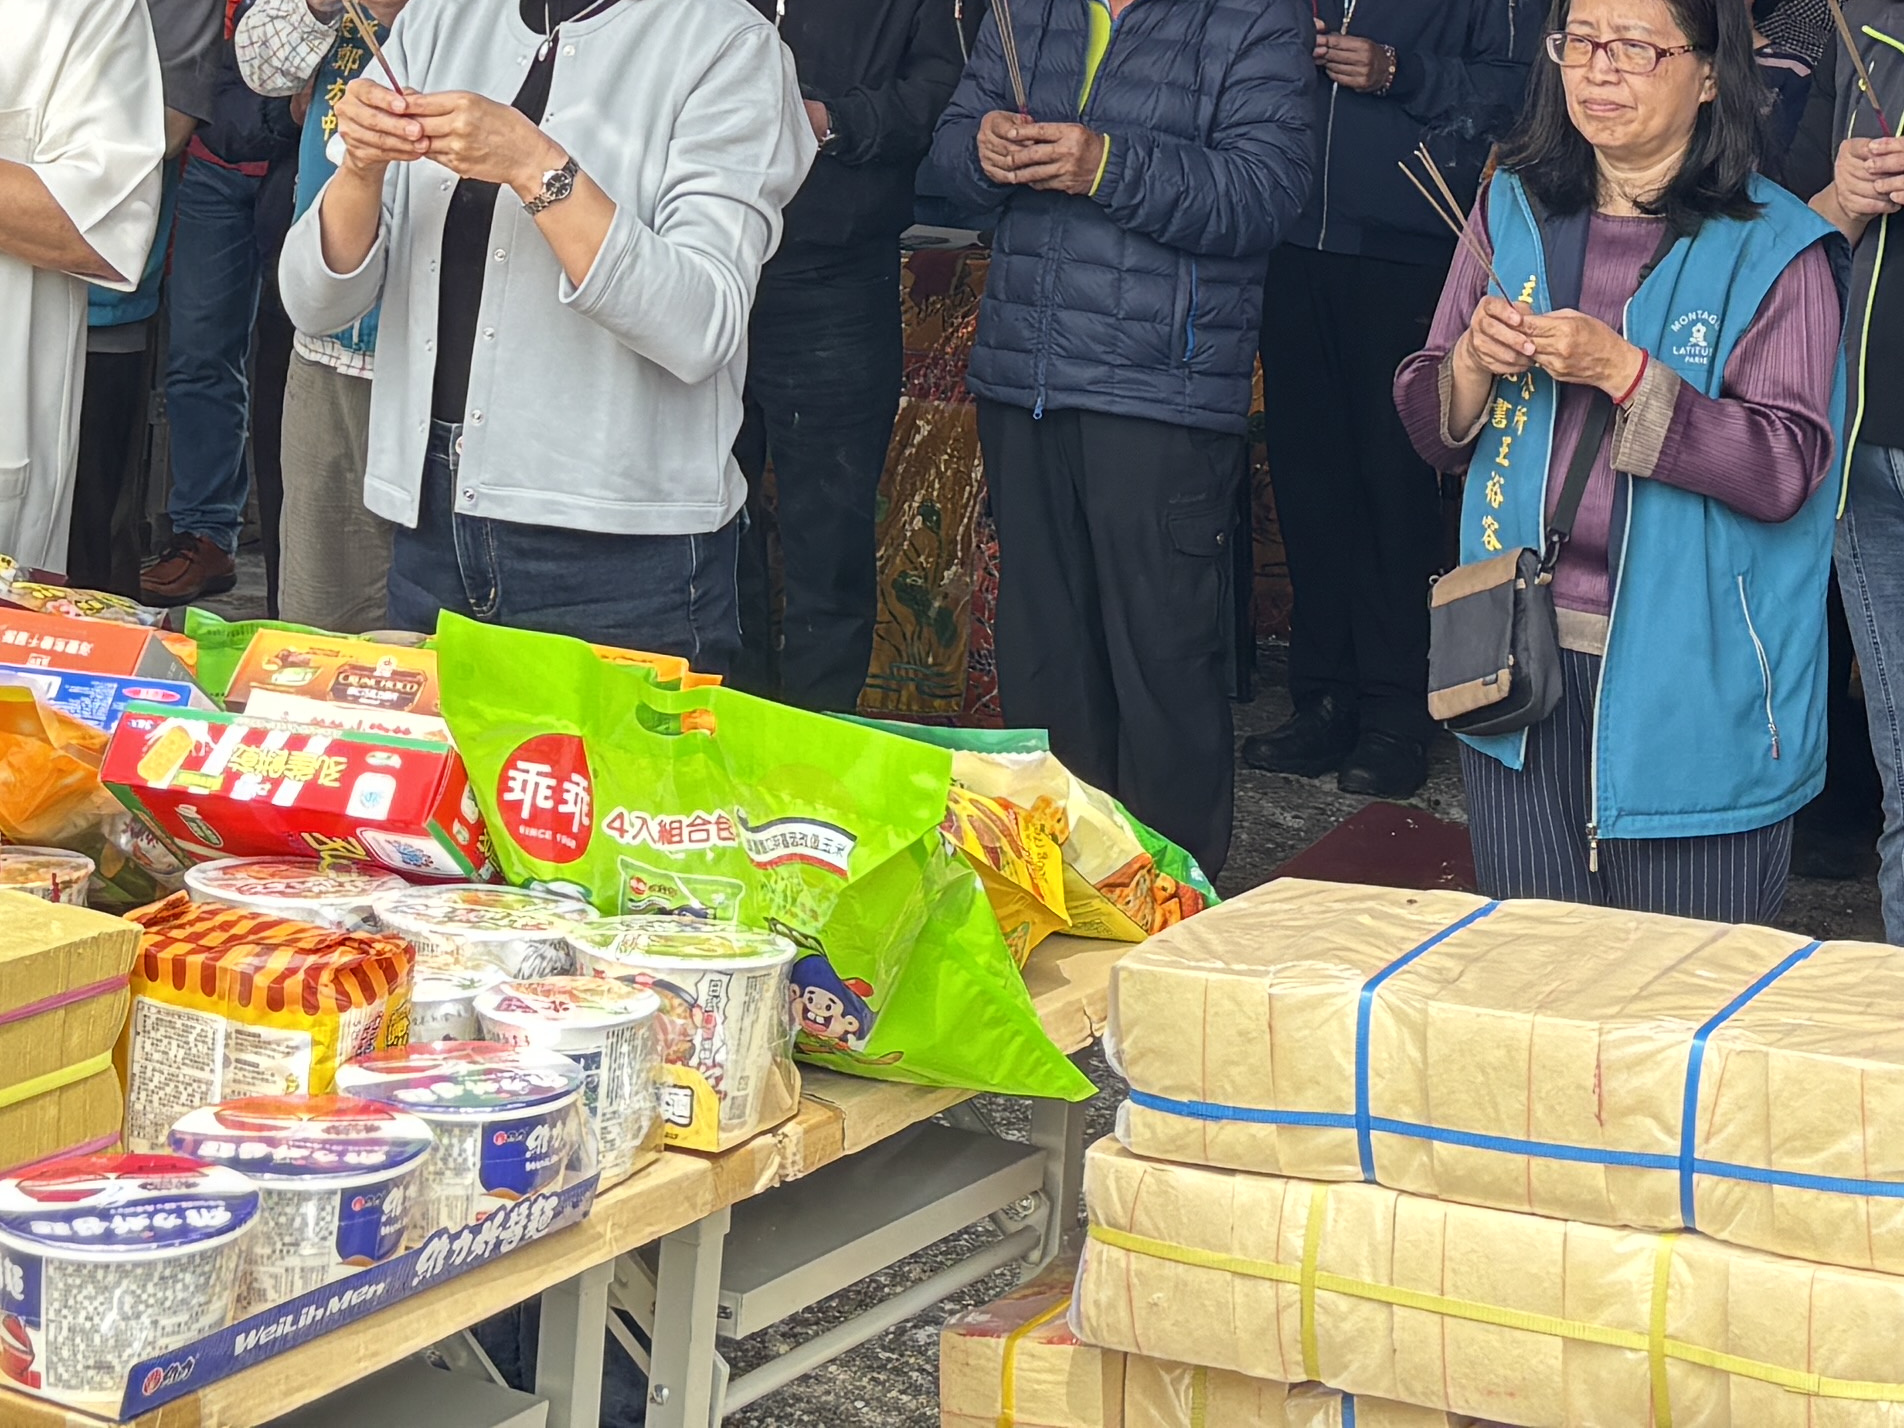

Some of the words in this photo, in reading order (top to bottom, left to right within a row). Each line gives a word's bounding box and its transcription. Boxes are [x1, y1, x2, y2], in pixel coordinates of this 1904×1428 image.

[1672, 345, 1713, 357] LATITU
[226, 742, 349, 789] 孔雀餅乾
[502, 759, 592, 834] 乖乖
[605, 810, 738, 846] 4入組合包
[327, 1281, 386, 1316] Men
